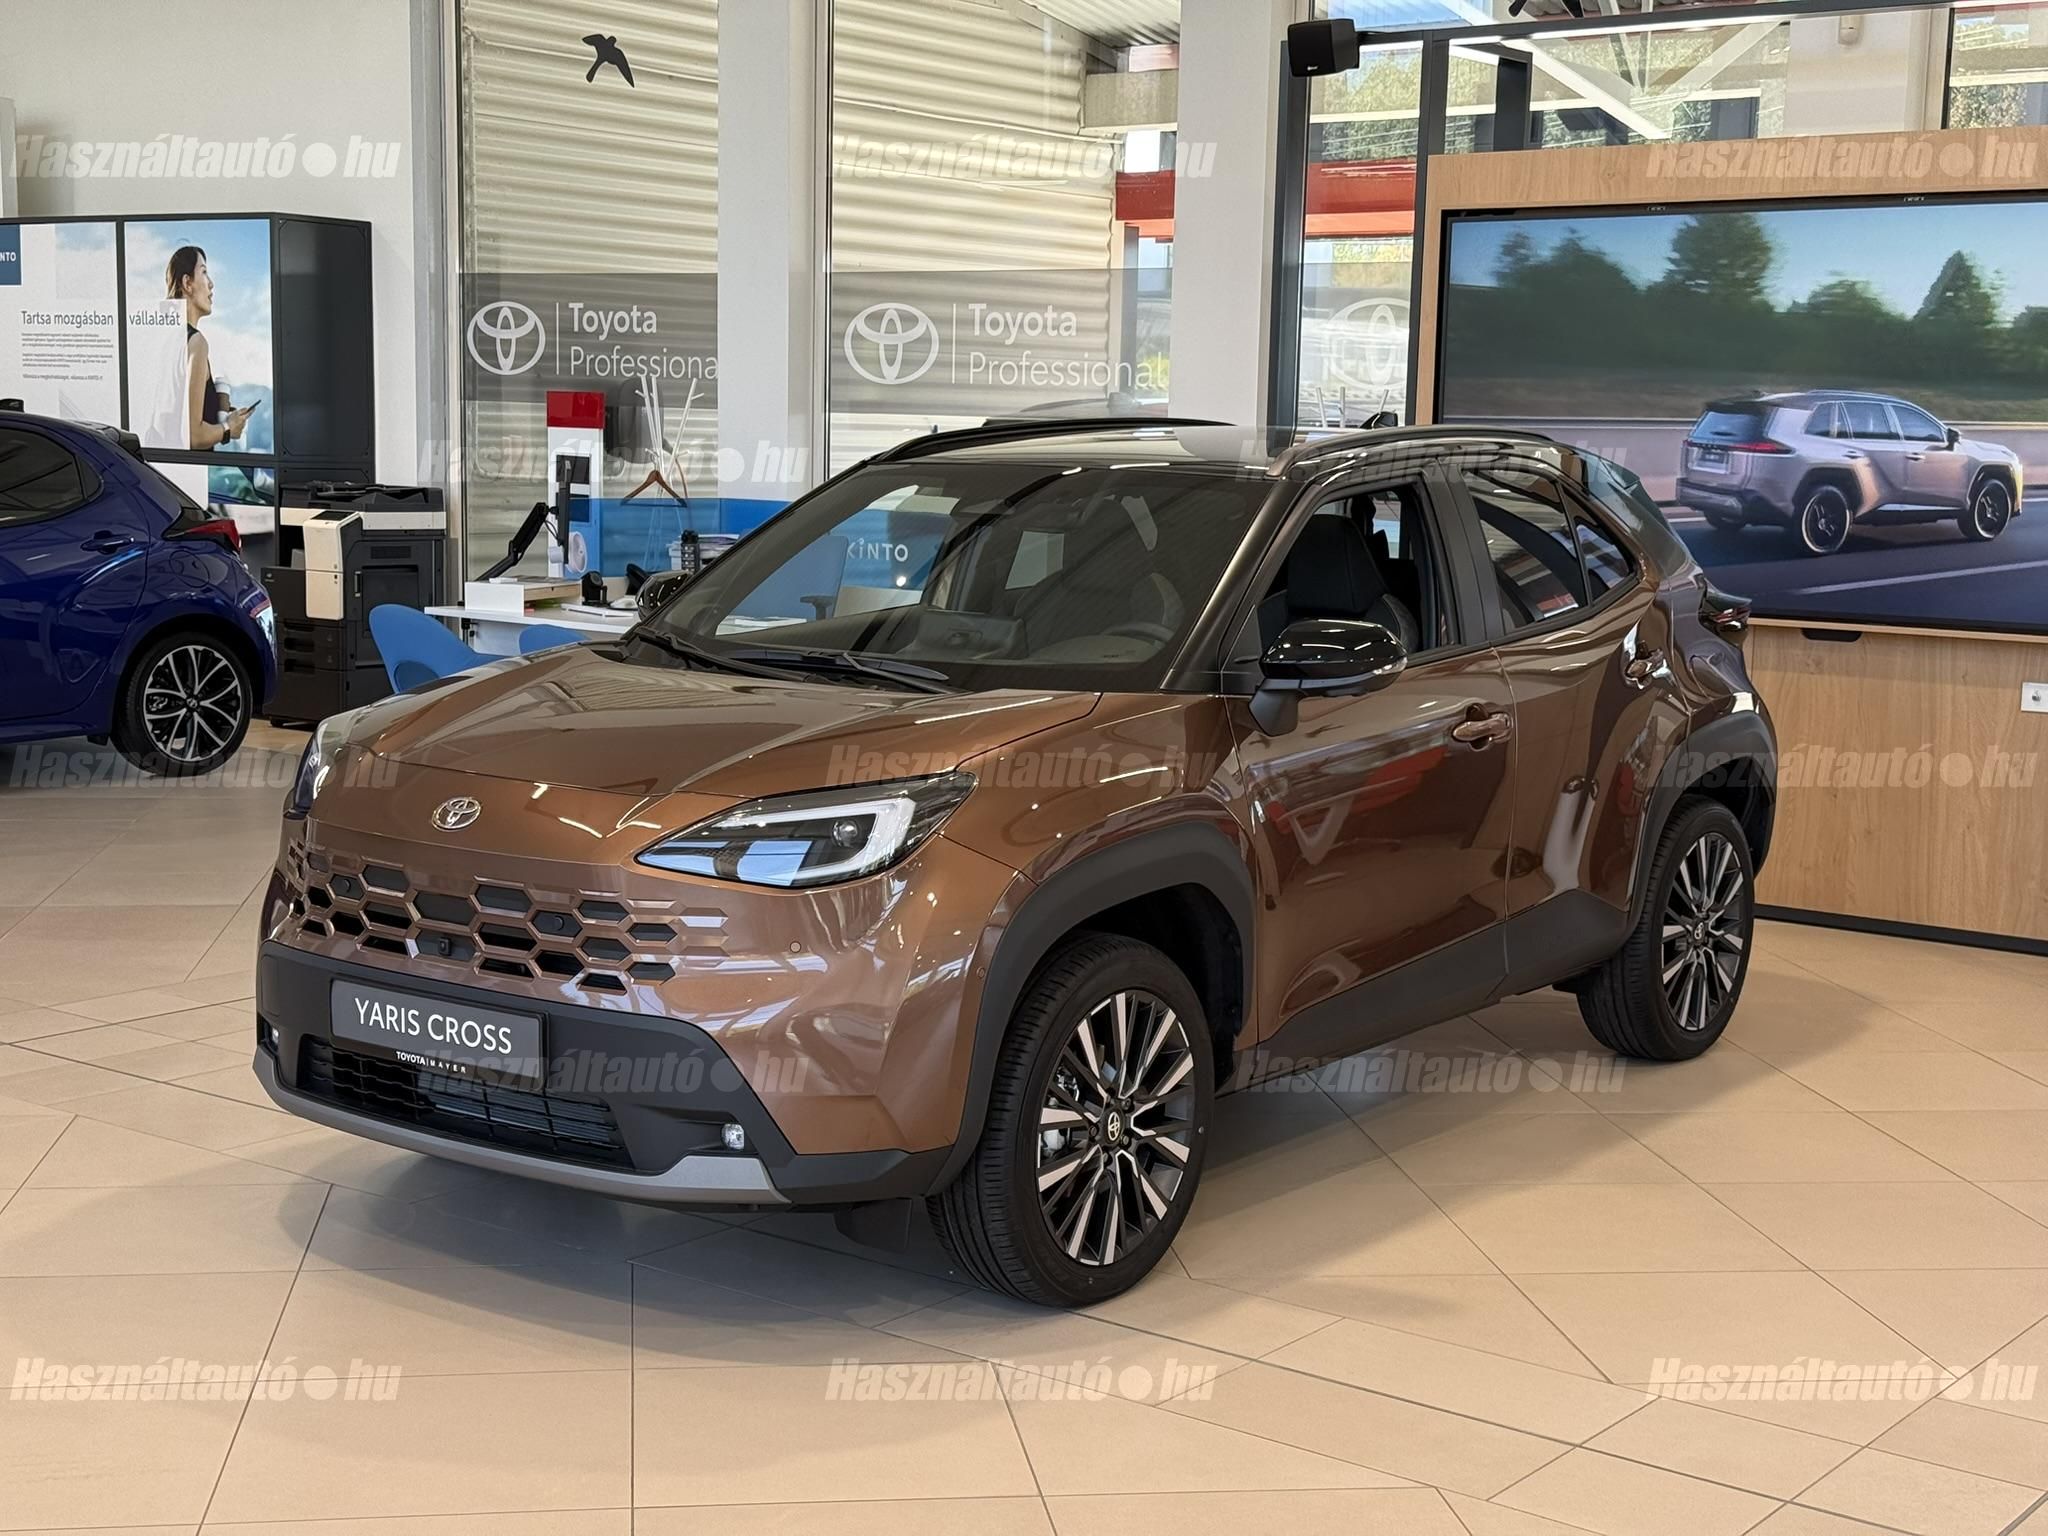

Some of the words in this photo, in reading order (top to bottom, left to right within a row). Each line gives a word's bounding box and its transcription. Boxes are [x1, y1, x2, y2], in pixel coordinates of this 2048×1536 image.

[21, 310, 51, 325] Tartsa
[54, 310, 114, 328] mozgásban
[129, 311, 181, 326] vállalatát
[568, 302, 657, 341] Toyota
[968, 303, 1078, 345] Toyota
[570, 345, 718, 379] Professiona
[969, 350, 1169, 387] Professional
[355, 998, 420, 1036] YARIS
[427, 1014, 512, 1054] CROSS
[396, 1051, 426, 1066] TOYOTA
